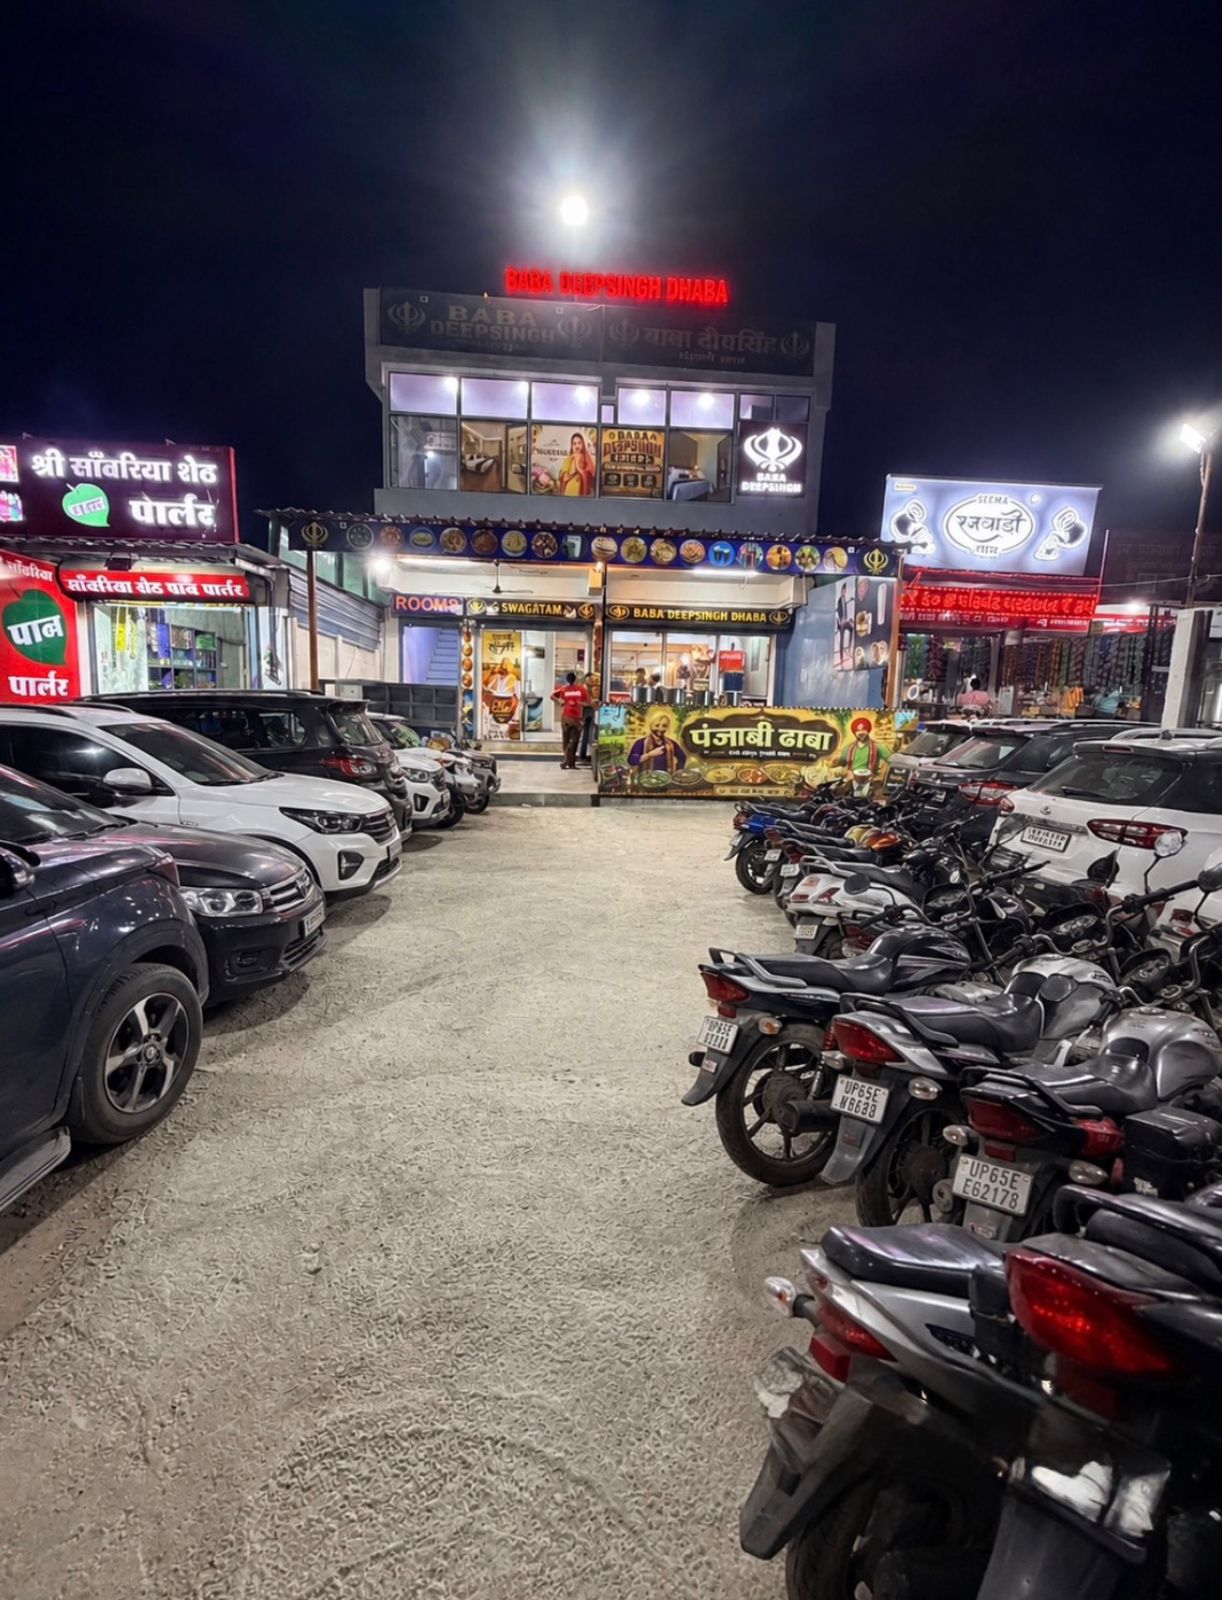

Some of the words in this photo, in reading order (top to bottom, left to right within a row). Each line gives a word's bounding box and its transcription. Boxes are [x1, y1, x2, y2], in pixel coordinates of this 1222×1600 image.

[504, 266, 553, 294] BABA
[559, 271, 662, 299] DEEPSINGH
[666, 277, 730, 304] DHABA
[448, 304, 539, 327] BABA
[429, 320, 555, 344] DEEPSINGH
[31, 448, 66, 478] श्री
[501, 602, 563, 616] SWAGATAM
[633, 607, 664, 620] BABA
[667, 609, 728, 623] DEEPSINGH
[731, 611, 768, 624] DHABA
[7, 614, 64, 647] पान
[690, 720, 774, 748] पंजाबी
[778, 727, 834, 751] ढाबा
[969, 1160, 1022, 1191] UP65E
[961, 1178, 1020, 1210] E62178
